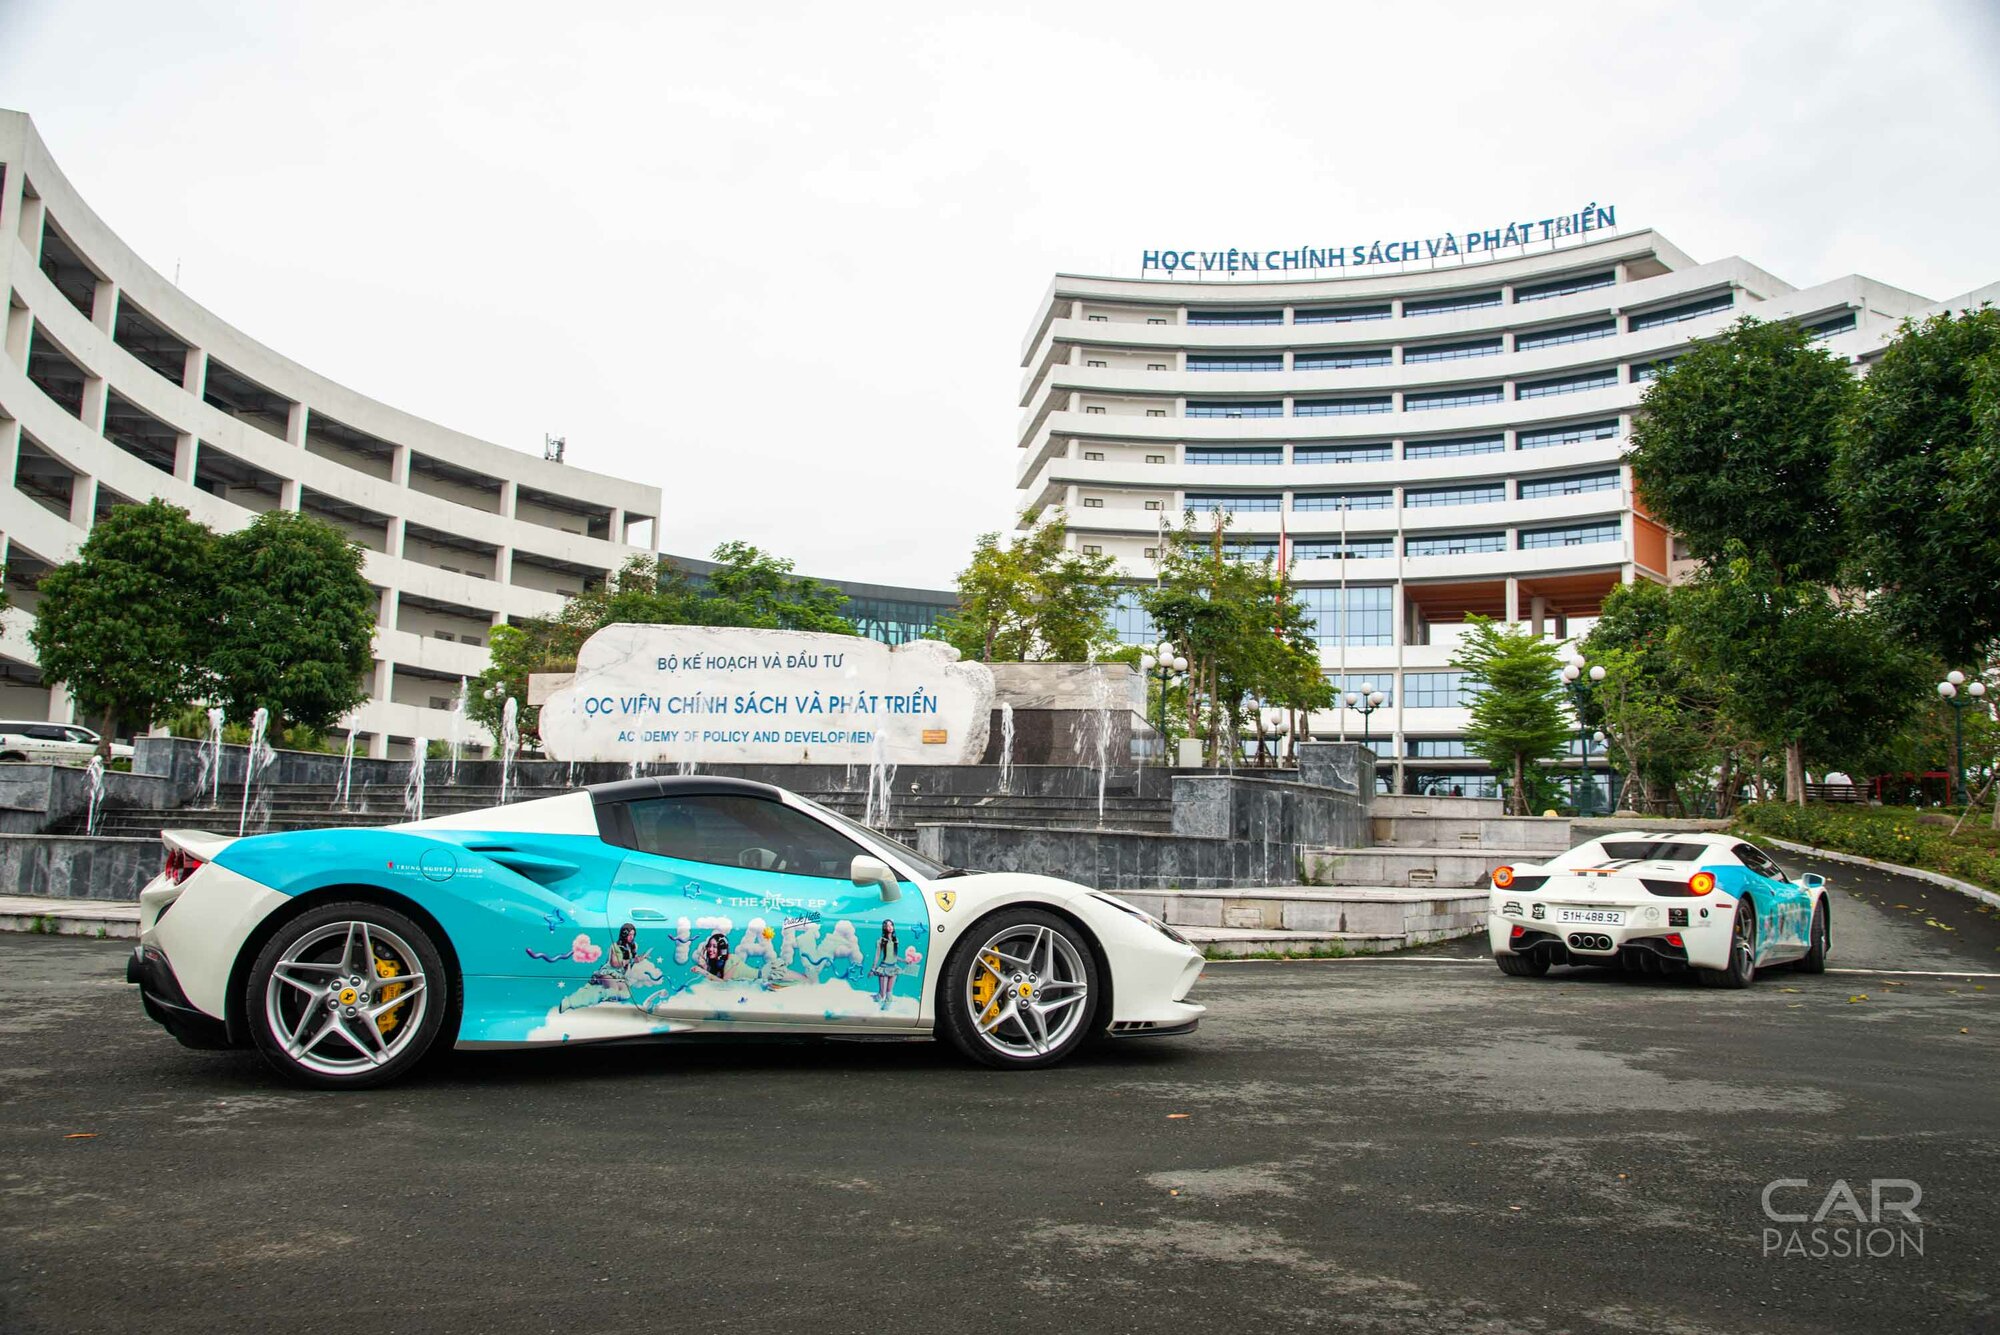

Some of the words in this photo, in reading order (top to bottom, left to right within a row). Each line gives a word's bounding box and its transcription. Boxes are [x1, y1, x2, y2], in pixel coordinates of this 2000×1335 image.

[1143, 250, 1196, 275] HỌC
[1200, 248, 1259, 276] VIỆN
[1265, 245, 1345, 272] CHÍNH
[1352, 241, 1419, 266] SÁCH
[1425, 233, 1459, 259] VÀ
[1467, 222, 1533, 253] PHÁT
[1539, 202, 1616, 239] TRIỂN
[657, 654, 678, 673] BỘ
[683, 652, 704, 670] KẾ
[706, 656, 757, 672] HOẠCH
[762, 652, 782, 669] VÀ
[786, 650, 818, 668] ĐẦU
[823, 653, 844, 668] TƯ
[572, 697, 614, 718] ỌC
[668, 691, 728, 714] CHÍNH
[734, 691, 788, 714] SÁCH
[795, 690, 823, 714] VÀ
[884, 686, 938, 714] TRIỂN
[618, 731, 679, 742] ACDEMY
[703, 731, 750, 743] POLICY
[752, 731, 780, 743] AND
[784, 731, 875, 743] DEVELOPMEN
[729, 897, 758, 907] THE
[807, 899, 826, 908] EP
[1562, 911, 1620, 923] 51H-488.92
